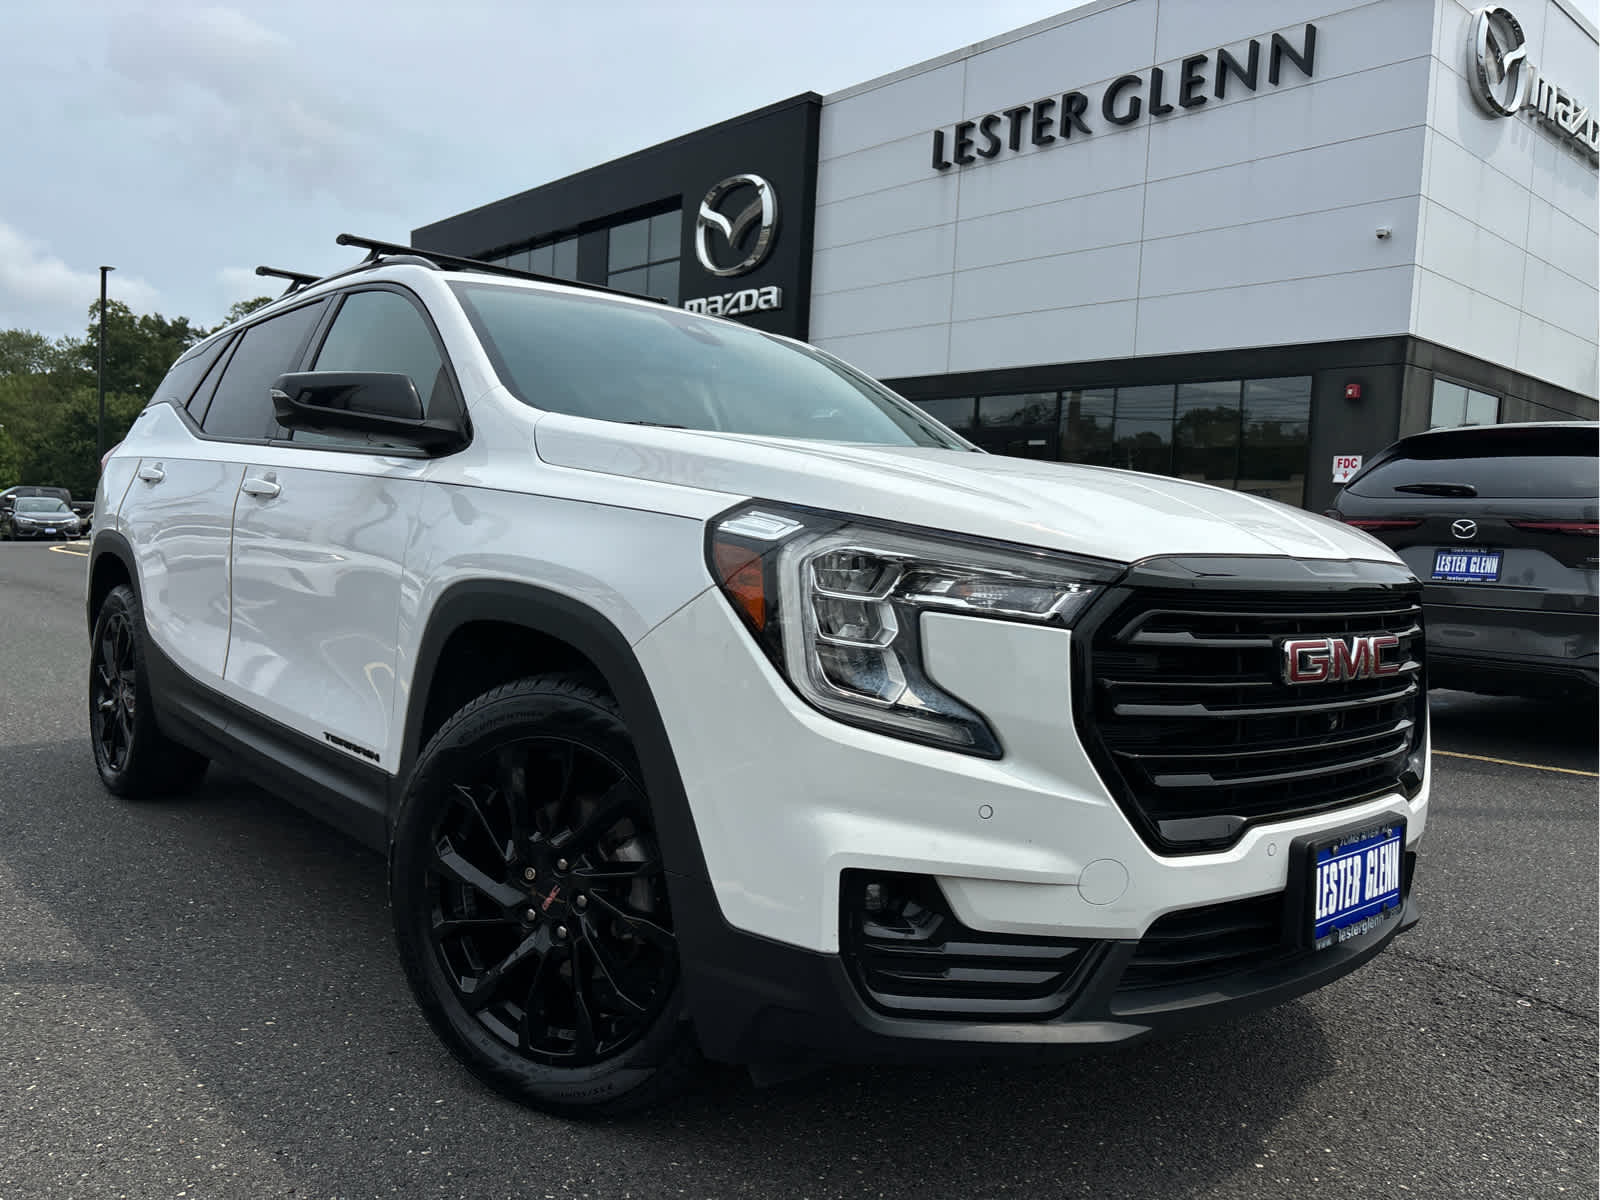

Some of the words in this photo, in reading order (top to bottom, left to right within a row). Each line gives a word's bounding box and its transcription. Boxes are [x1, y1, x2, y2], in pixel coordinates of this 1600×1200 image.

[932, 91, 1093, 171] LESTER
[1101, 23, 1317, 126] GLENN
[684, 285, 782, 315] mazda
[1337, 457, 1358, 469] FDC
[1435, 555, 1468, 572] LESTER
[1469, 556, 1499, 574] GLENN
[1284, 635, 1400, 685] GMC
[1315, 854, 1362, 921] LESTER
[1365, 840, 1400, 901] GLENN
